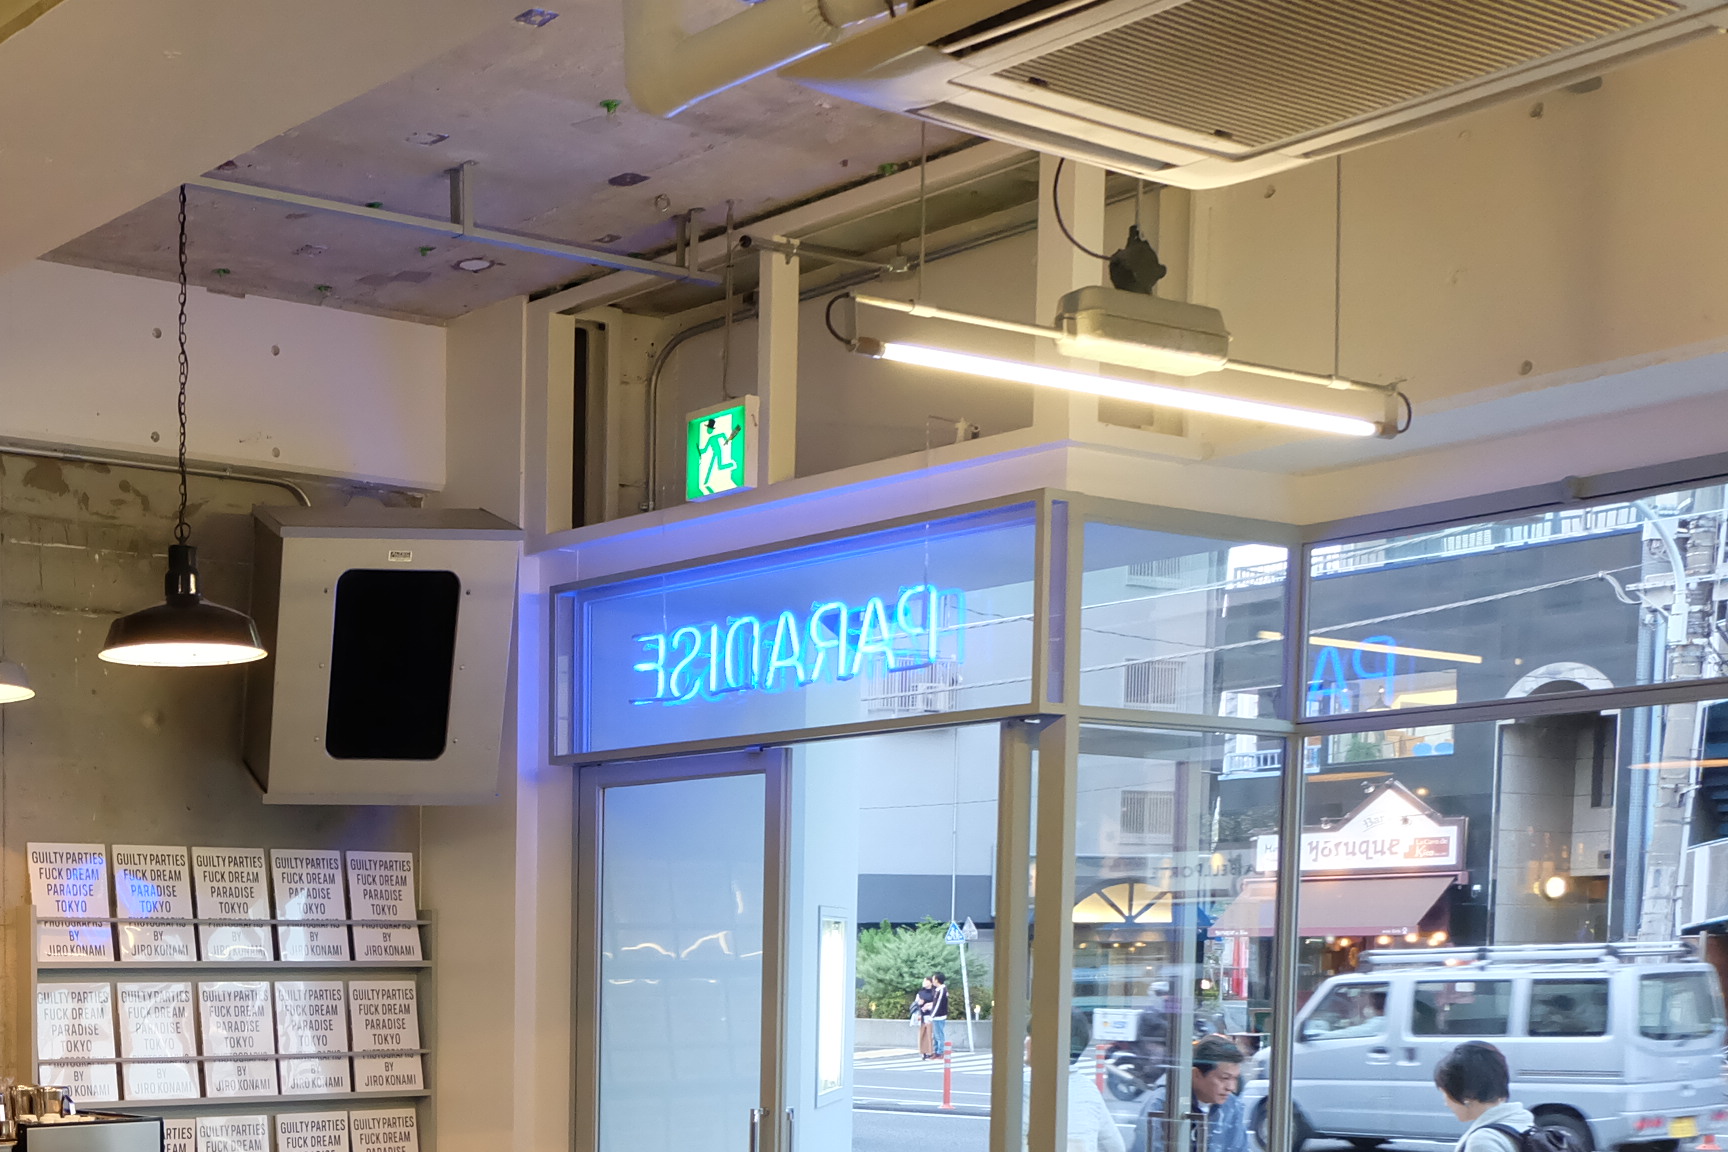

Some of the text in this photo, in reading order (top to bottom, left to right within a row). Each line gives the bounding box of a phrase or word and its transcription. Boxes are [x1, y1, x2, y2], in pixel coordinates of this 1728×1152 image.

[32, 851, 104, 865] GUILTY PARTIES
[117, 853, 185, 866] GUILTY PARTIES
[197, 855, 263, 868] GUILTY PARTIES
[275, 857, 339, 870] GUILTY PARTIES
[351, 859, 411, 872] GUILTY PARTIES
[39, 868, 99, 880] FUCK DREAM
[124, 869, 181, 881] FUCK DREAM
[203, 871, 259, 883] FUCK DREAM
[282, 872, 335, 884] FUCK DREAM
[357, 874, 407, 886] FUCK DREAM
[47, 884, 93, 896] PARADISE
[131, 885, 177, 897] PARADISE
[211, 886, 254, 898] PARADISE
[289, 887, 331, 899] PARADISE
[363, 889, 403, 901] PARADISE
[56, 900, 87, 912] TOKYO
[141, 901, 171, 913] TOKYO
[219, 902, 248, 914] TOKYO
[371, 904, 397, 916] TOKYO
[69, 931, 79, 941] BY
[154, 931, 163, 941] BY
[310, 931, 318, 941] BY
[383, 932, 392, 941] BY
[47, 945, 105, 956] JIRO KONAMI
[131, 945, 152, 956] JIRO
[311, 945, 342, 956] KONAMI
[364, 945, 414, 956] JIRO KONAMI
[72, 991, 109, 1004] PARTIES
[203, 990, 232, 1002] GUILTY
[309, 989, 341, 1001] PARTIES
[353, 989, 414, 1001] GUILTY PARTIES
[44, 1007, 104, 1020] FUCK DREAM
[154, 1006, 185, 1018] DREAM
[210, 1006, 231, 1017] FUCK
[309, 1004, 338, 1016] DREAM
[359, 1004, 410, 1015] FUCK DREAM
[365, 1018, 406, 1029] PARADISE
[52, 1024, 99, 1036] PARADISE
[225, 1036, 254, 1048] TOKYO
[372, 1033, 400, 1045] TOKYO
[61, 1040, 92, 1052] TOKYO
[237, 1066, 246, 1076] BY
[385, 1062, 393, 1072] BY
[73, 1071, 84, 1081] BY
[365, 1074, 416, 1086] JIRO KONAMI
[75, 1085, 110, 1097] KONAMI
[281, 1119, 345, 1134] GUILTY PARTIES
[354, 1116, 414, 1131] GUILTY PARTIES
[163, 1128, 192, 1139] RTIES
[200, 1124, 265, 1137] GUILTY PARTIES
[287, 1135, 341, 1148] FUCK DREAM
[360, 1131, 410, 1145] FUCK DREAM
[206, 1140, 262, 1152] FUCK DREAM
